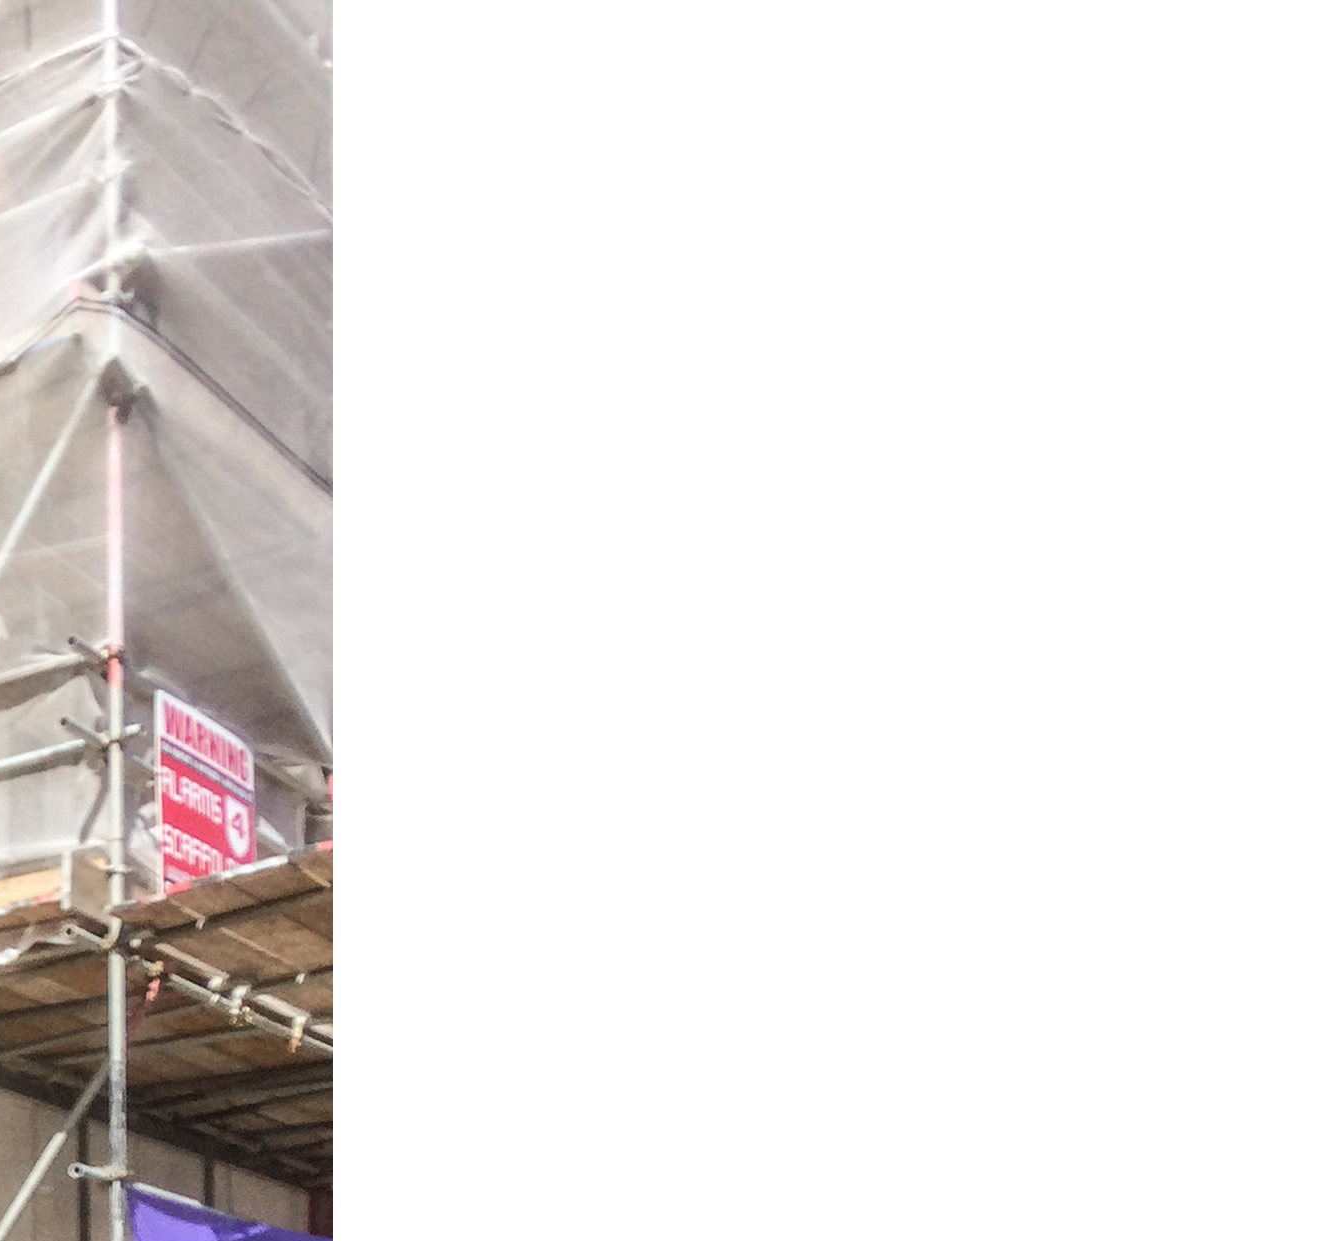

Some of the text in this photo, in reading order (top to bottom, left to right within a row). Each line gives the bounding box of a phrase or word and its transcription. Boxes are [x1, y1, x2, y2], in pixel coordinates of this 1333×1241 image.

[162, 701, 250, 783] WARNING
[161, 765, 224, 826] ALARMS
[161, 822, 240, 876] SCAFFOL
[231, 811, 244, 840] 4
